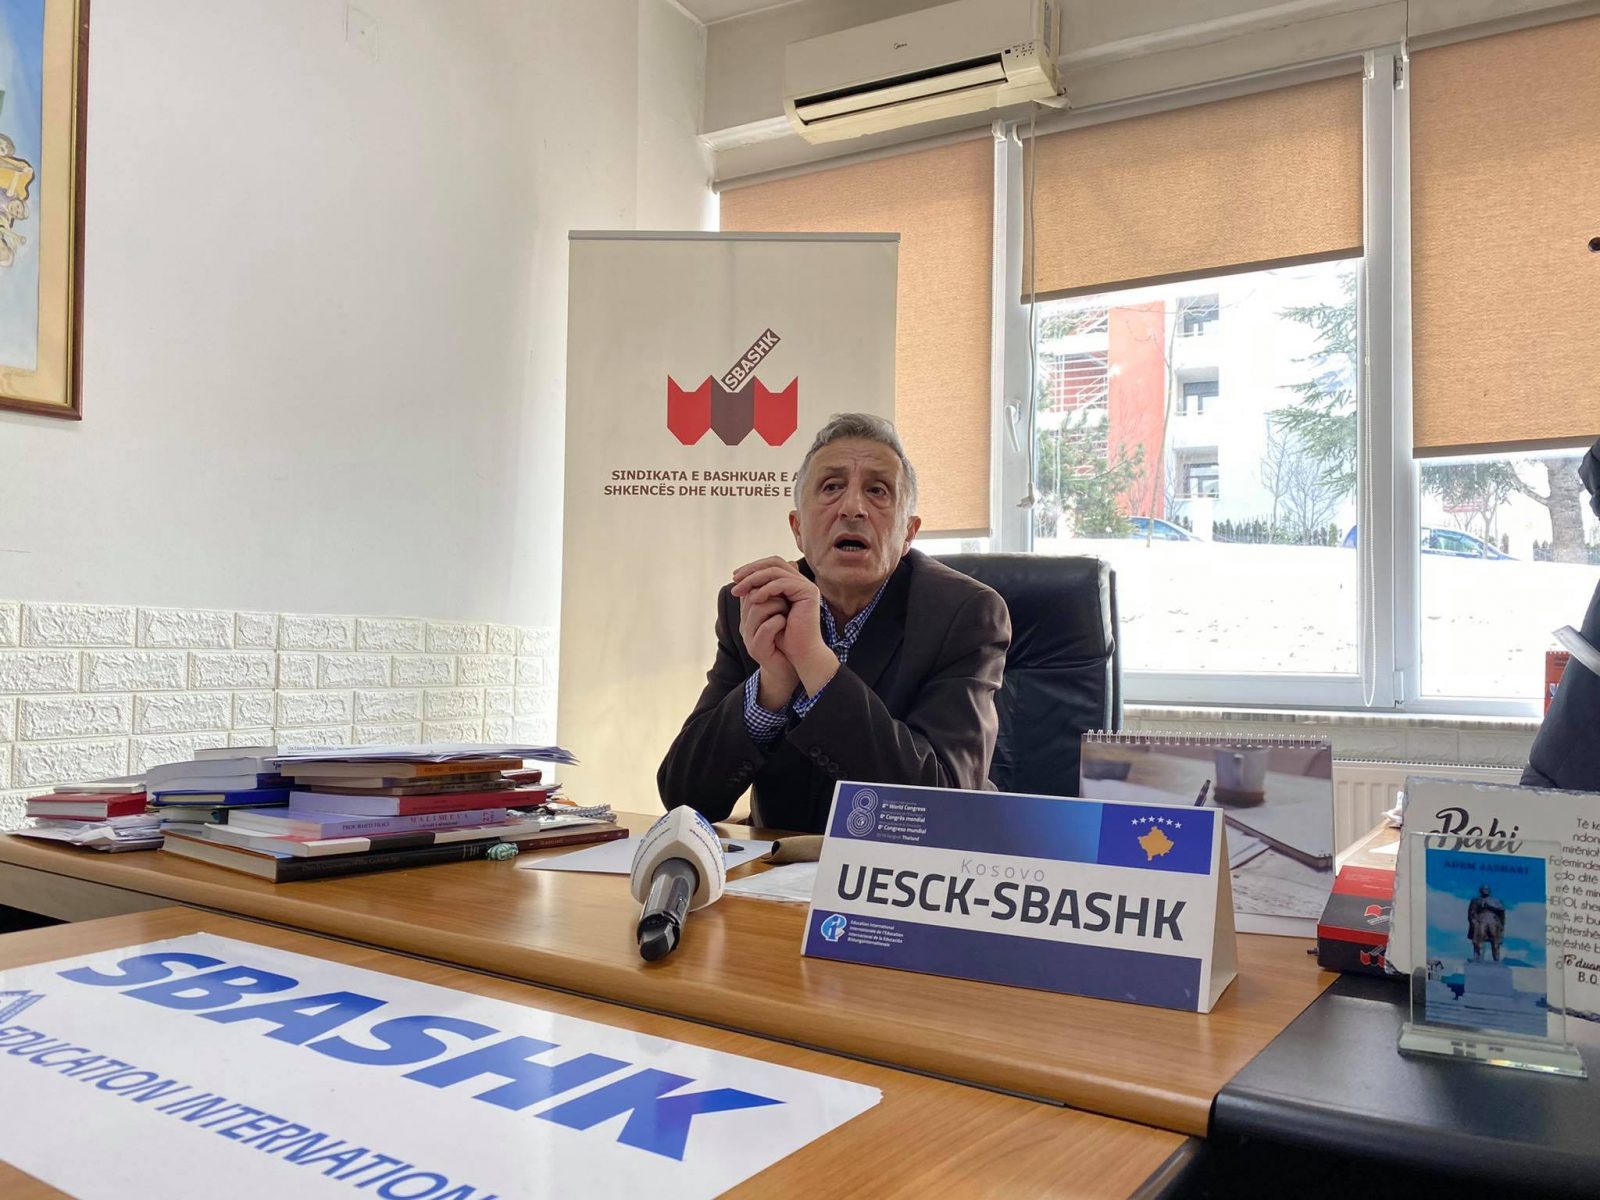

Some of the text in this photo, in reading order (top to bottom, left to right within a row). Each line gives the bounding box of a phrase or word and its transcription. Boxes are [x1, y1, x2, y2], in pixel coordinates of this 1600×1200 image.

[725, 330, 778, 389] SBASHK
[604, 483, 791, 497] SHKENCËS DHE KULTURËS E
[611, 470, 687, 481] SINDIKATA
[692, 471, 699, 480] E
[703, 471, 776, 481] BASHKUAR
[781, 472, 788, 481] E
[1424, 807, 1523, 853] Babi
[961, 858, 1046, 882] Kosovo
[1444, 860, 1529, 875] ADEM JASHARI
[837, 863, 1188, 941] UESCK-SBASHK
[56, 951, 787, 1162] SBASHK
